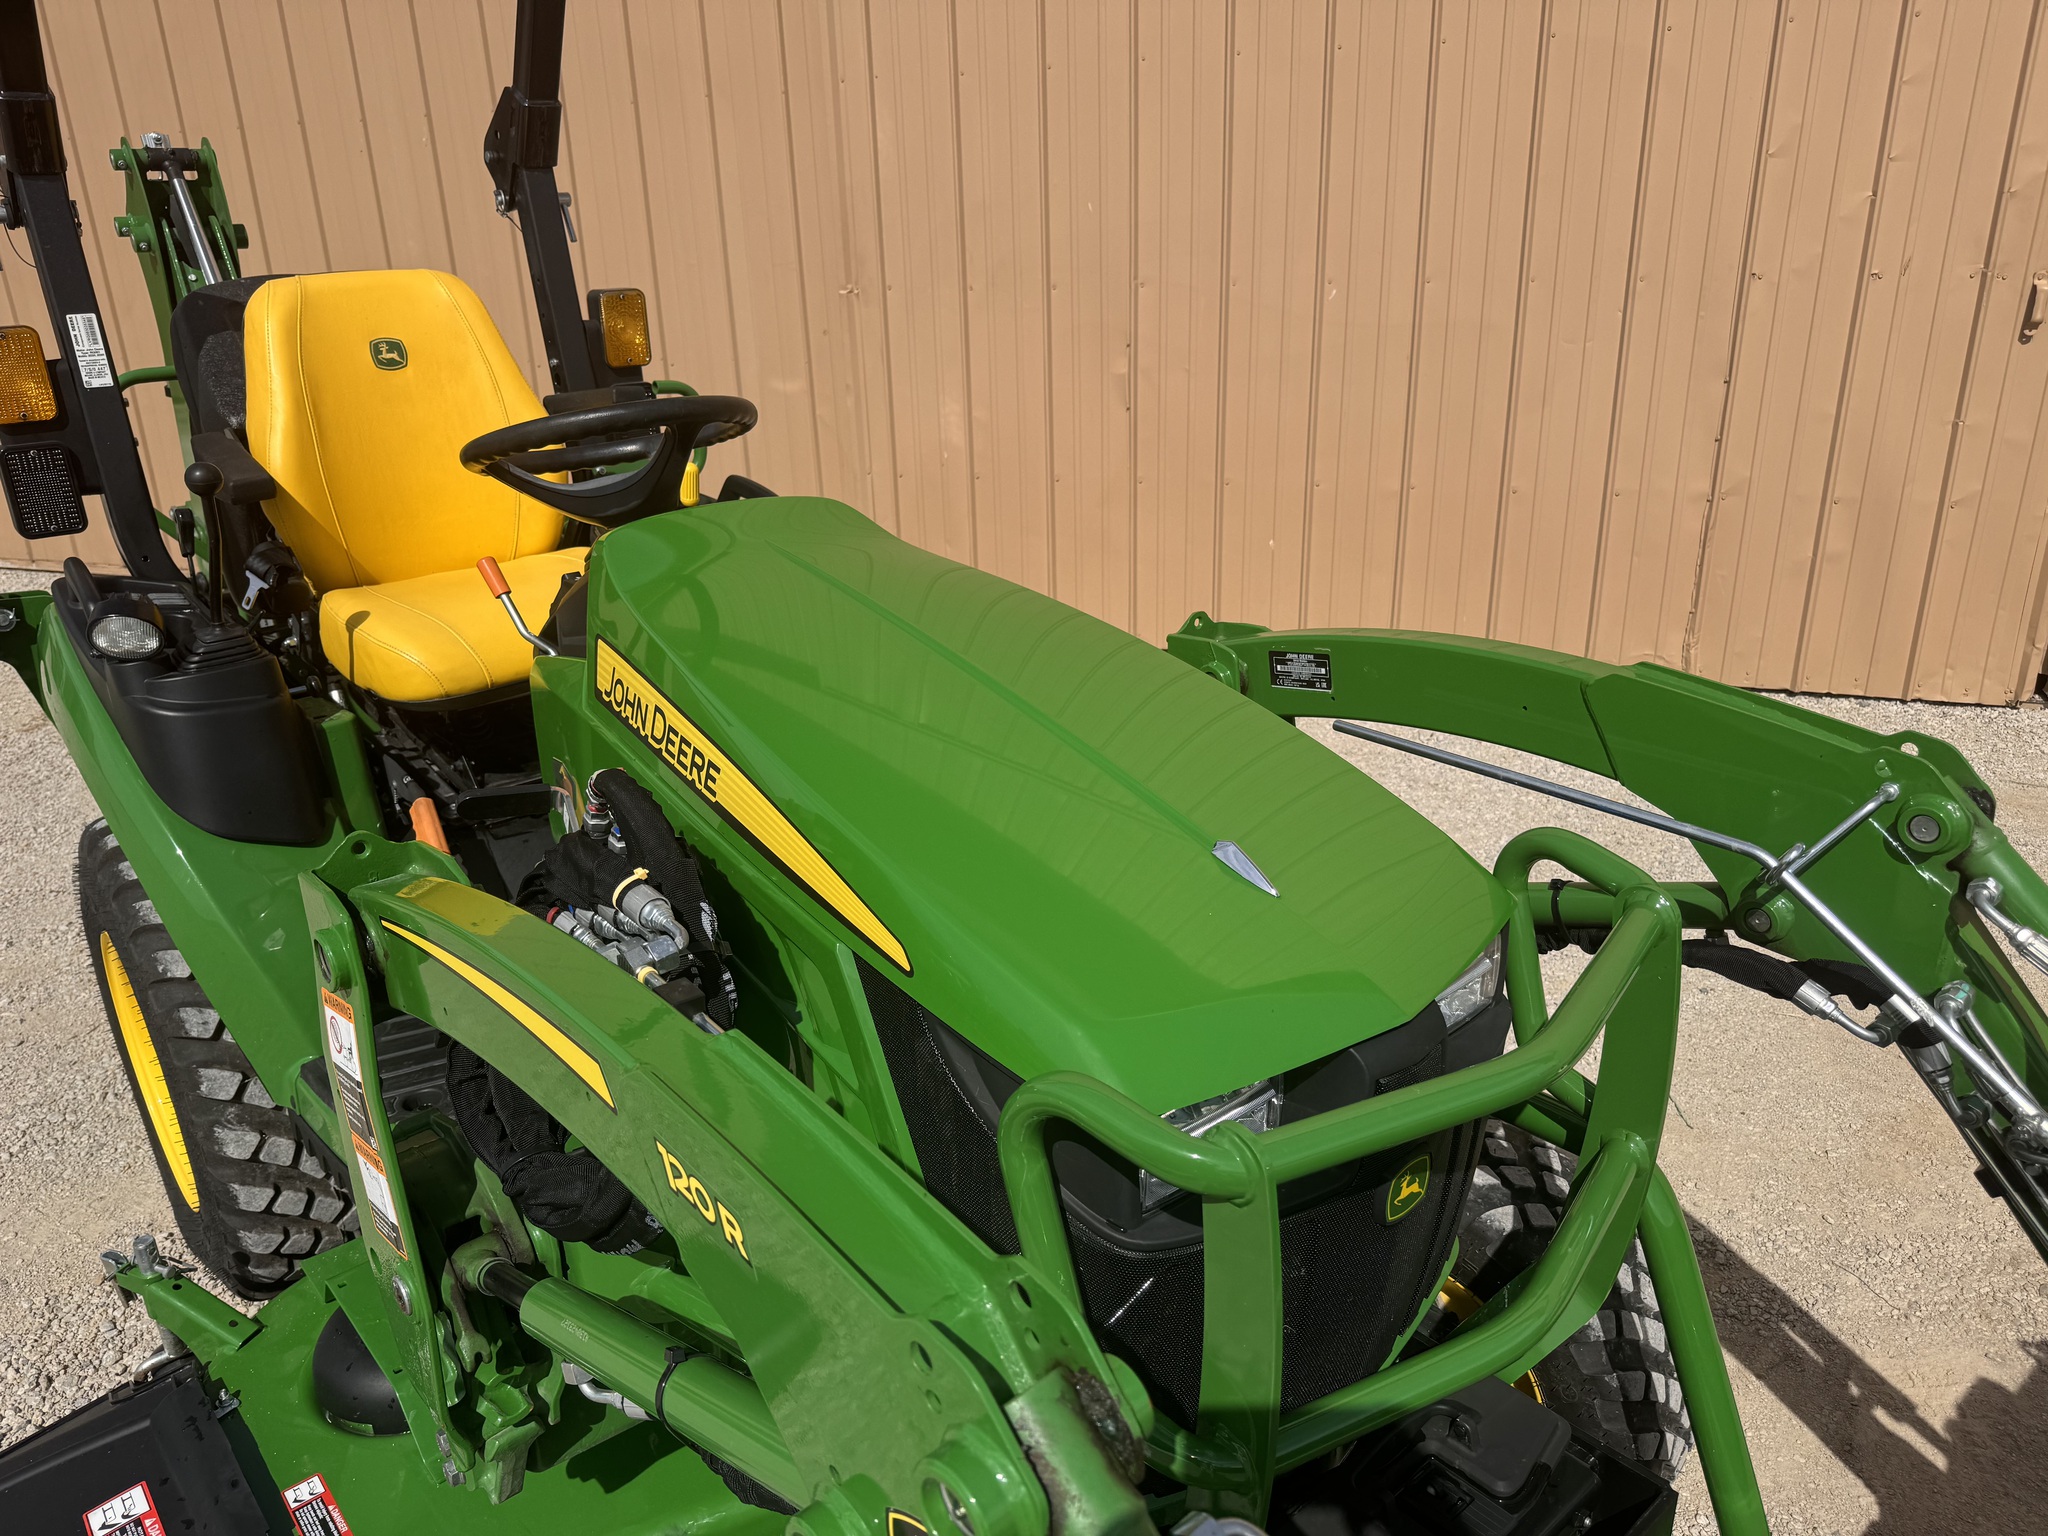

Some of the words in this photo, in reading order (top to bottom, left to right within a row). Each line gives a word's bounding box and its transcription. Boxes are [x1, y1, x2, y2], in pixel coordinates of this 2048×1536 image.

[604, 667, 649, 733] JOHN
[650, 704, 722, 799] DEERE
[328, 996, 352, 1020] WARNING
[358, 1143, 384, 1172] WARNING
[330, 1508, 349, 1533] DANGER
